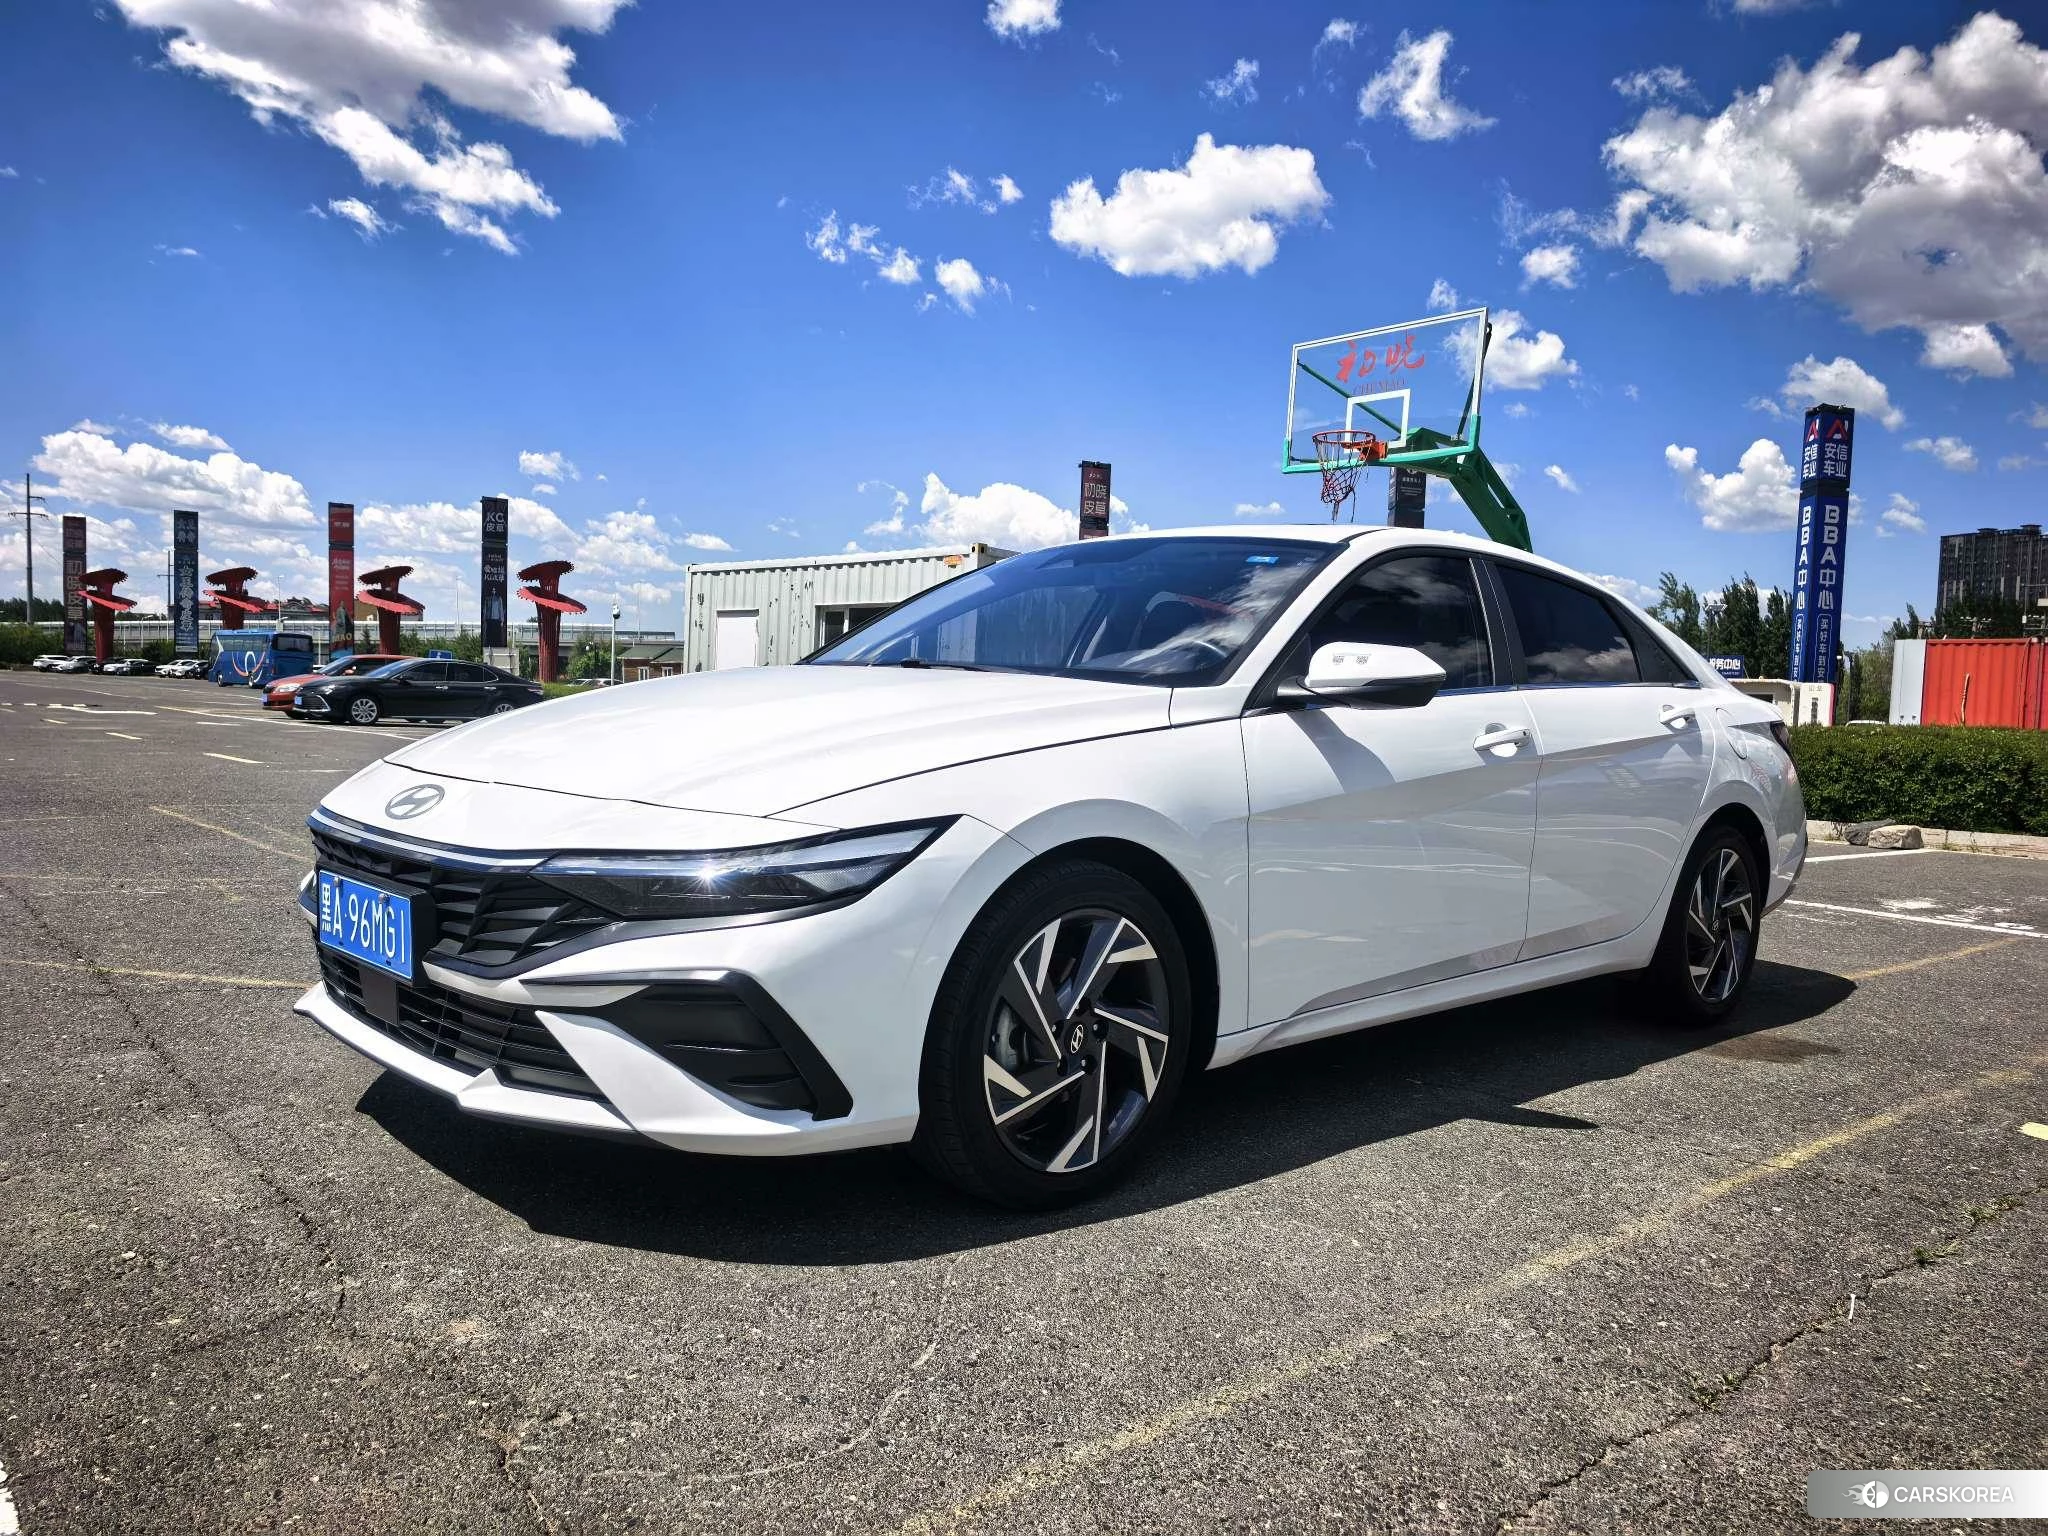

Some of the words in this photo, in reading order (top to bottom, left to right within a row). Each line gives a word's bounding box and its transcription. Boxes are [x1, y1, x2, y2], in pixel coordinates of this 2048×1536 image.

[1804, 443, 1818, 463] 安信
[1824, 442, 1848, 461] 安信
[1802, 460, 1817, 480] 车业
[1823, 460, 1847, 478] 车业
[1084, 482, 1108, 499] 初晓
[1796, 505, 1812, 610] BBA中心
[1818, 504, 1840, 610] BBA中心
